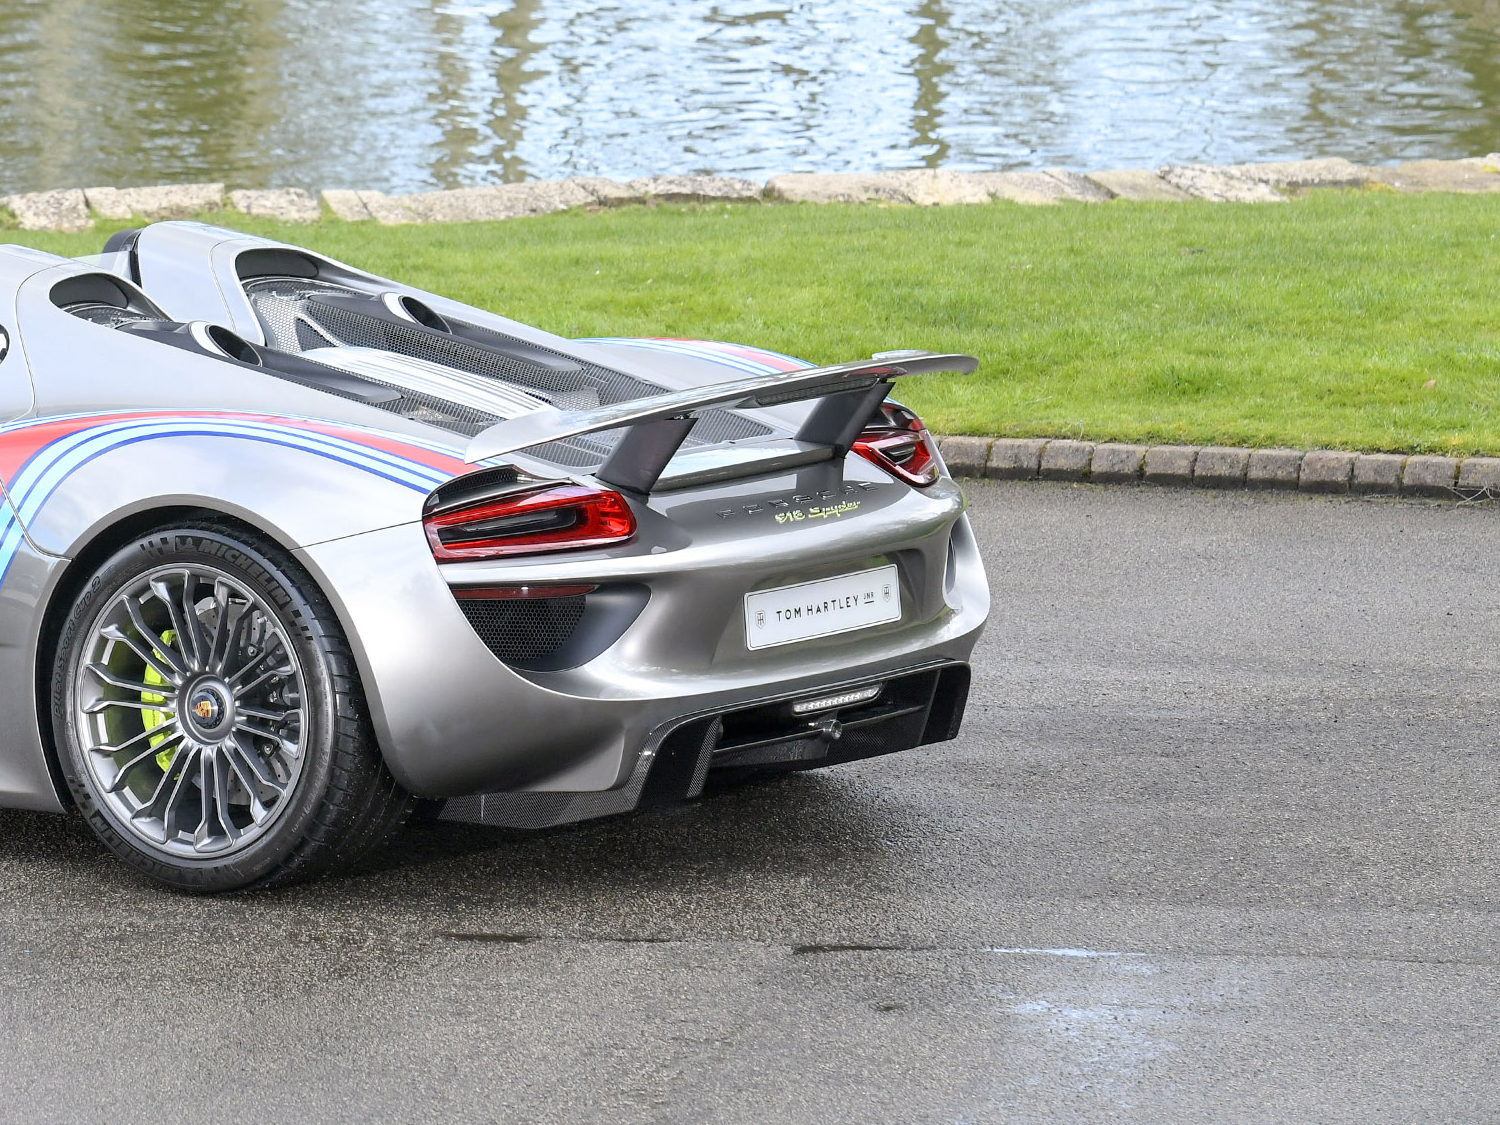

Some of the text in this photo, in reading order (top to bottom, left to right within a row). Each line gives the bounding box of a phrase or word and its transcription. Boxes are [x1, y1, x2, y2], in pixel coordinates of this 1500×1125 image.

[808, 500, 861, 519] Spyder
[196, 537, 292, 610] MICHELIN
[56, 619, 76, 671] Sport
[73, 589, 92, 620] Cup
[776, 591, 875, 622] TOM HARTLEY JNR
